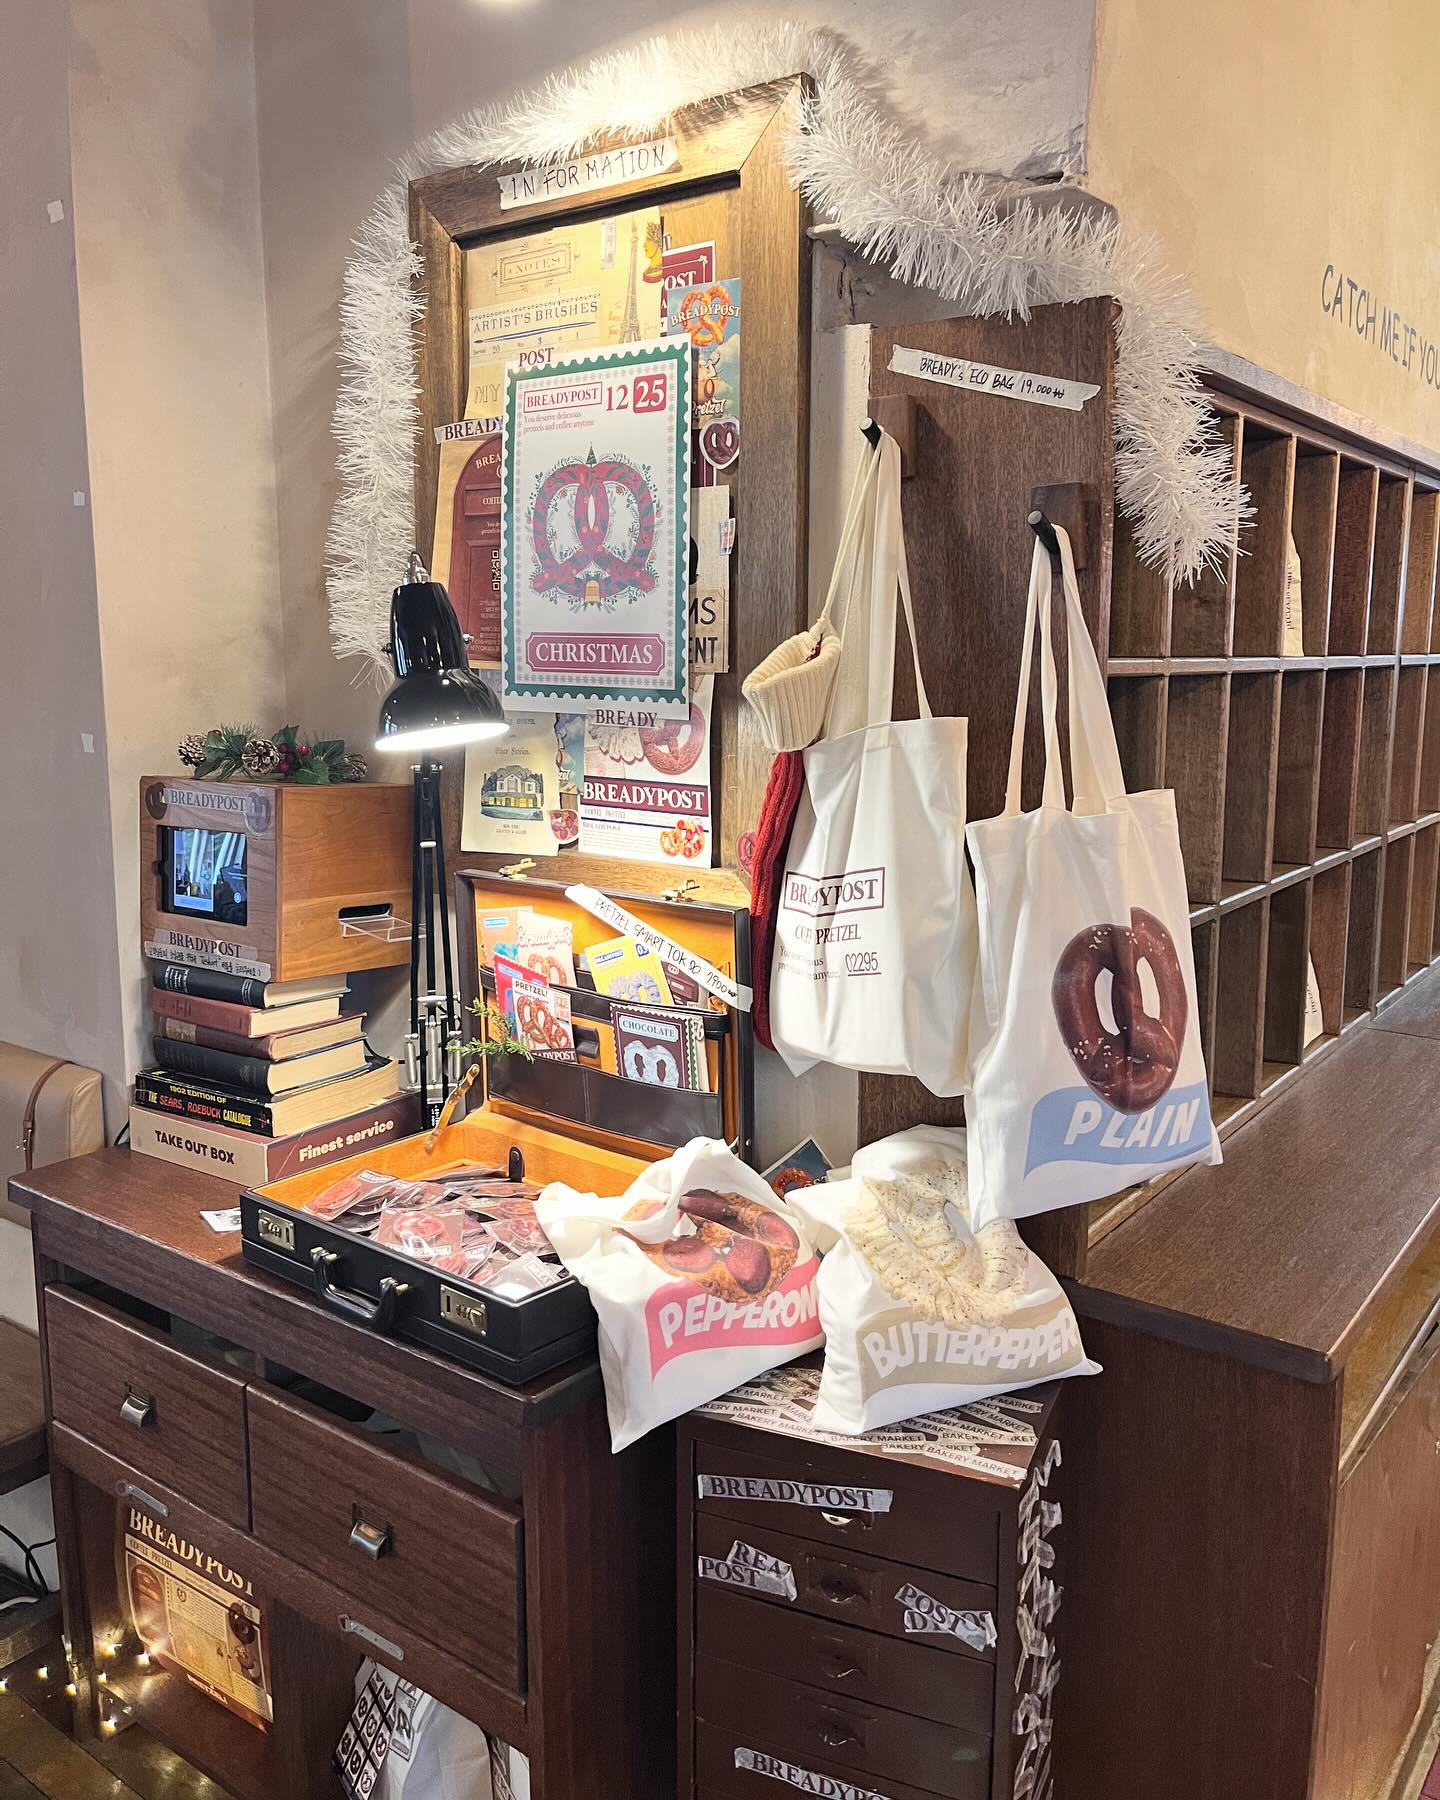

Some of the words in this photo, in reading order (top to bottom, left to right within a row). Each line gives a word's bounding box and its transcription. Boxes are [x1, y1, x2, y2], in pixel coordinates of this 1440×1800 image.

[473, 312, 532, 333] ARTIST'S
[671, 303, 741, 327] BREADYPOST
[1321, 264, 1377, 345] CATCH
[1379, 306, 1400, 362] ME
[1402, 323, 1417, 372] IF
[518, 347, 555, 367] POST
[969, 368, 989, 385] ECO
[992, 373, 1015, 390] BAG
[526, 387, 600, 409] BREADYPOST
[606, 384, 629, 412] 12
[635, 378, 666, 409] 25
[535, 642, 653, 665] CHRISTMAS
[595, 709, 657, 728] BREADY
[170, 790, 246, 812] BREADYPOST
[583, 781, 705, 811] BREADYPOST
[595, 897, 629, 932] PRETZEL
[633, 923, 665, 952] SMART
[816, 923, 862, 945] PRETZEL
[845, 951, 879, 973] 02295
[515, 980, 549, 997] PRETZEL!
[621, 1018, 676, 1038] CHOCOLATE
[148, 1091, 158, 1104] THE
[187, 1101, 221, 1119] ROEBUCK
[169, 1085, 187, 1095] 1902
[186, 1089, 217, 1102] EDITION
[216, 1096, 227, 1104] OF
[1063, 1097, 1201, 1149] PLAIN
[155, 1129, 184, 1149] TAKE
[184, 1139, 208, 1158] OUT
[210, 1147, 235, 1165] BOX
[299, 1136, 345, 1163] Finest
[345, 1118, 395, 1146] service
[862, 1306, 1080, 1379] BUTTERPEPPER
[744, 1389, 785, 1401] MARKET
[998, 1398, 1041, 1411] MARKET
[733, 1406, 777, 1415] MARKET
[736, 1412, 777, 1426] BAKERY
[959, 1423, 1005, 1439] MARKET
[989, 1412, 1030, 1432] MARKET
[927, 1446, 970, 1462] BAKERY
[971, 1459, 1018, 1475] MARKET
[709, 1476, 873, 1510] BREADYPOST
[701, 1557, 760, 1588] POST
[898, 1585, 967, 1633] POST
